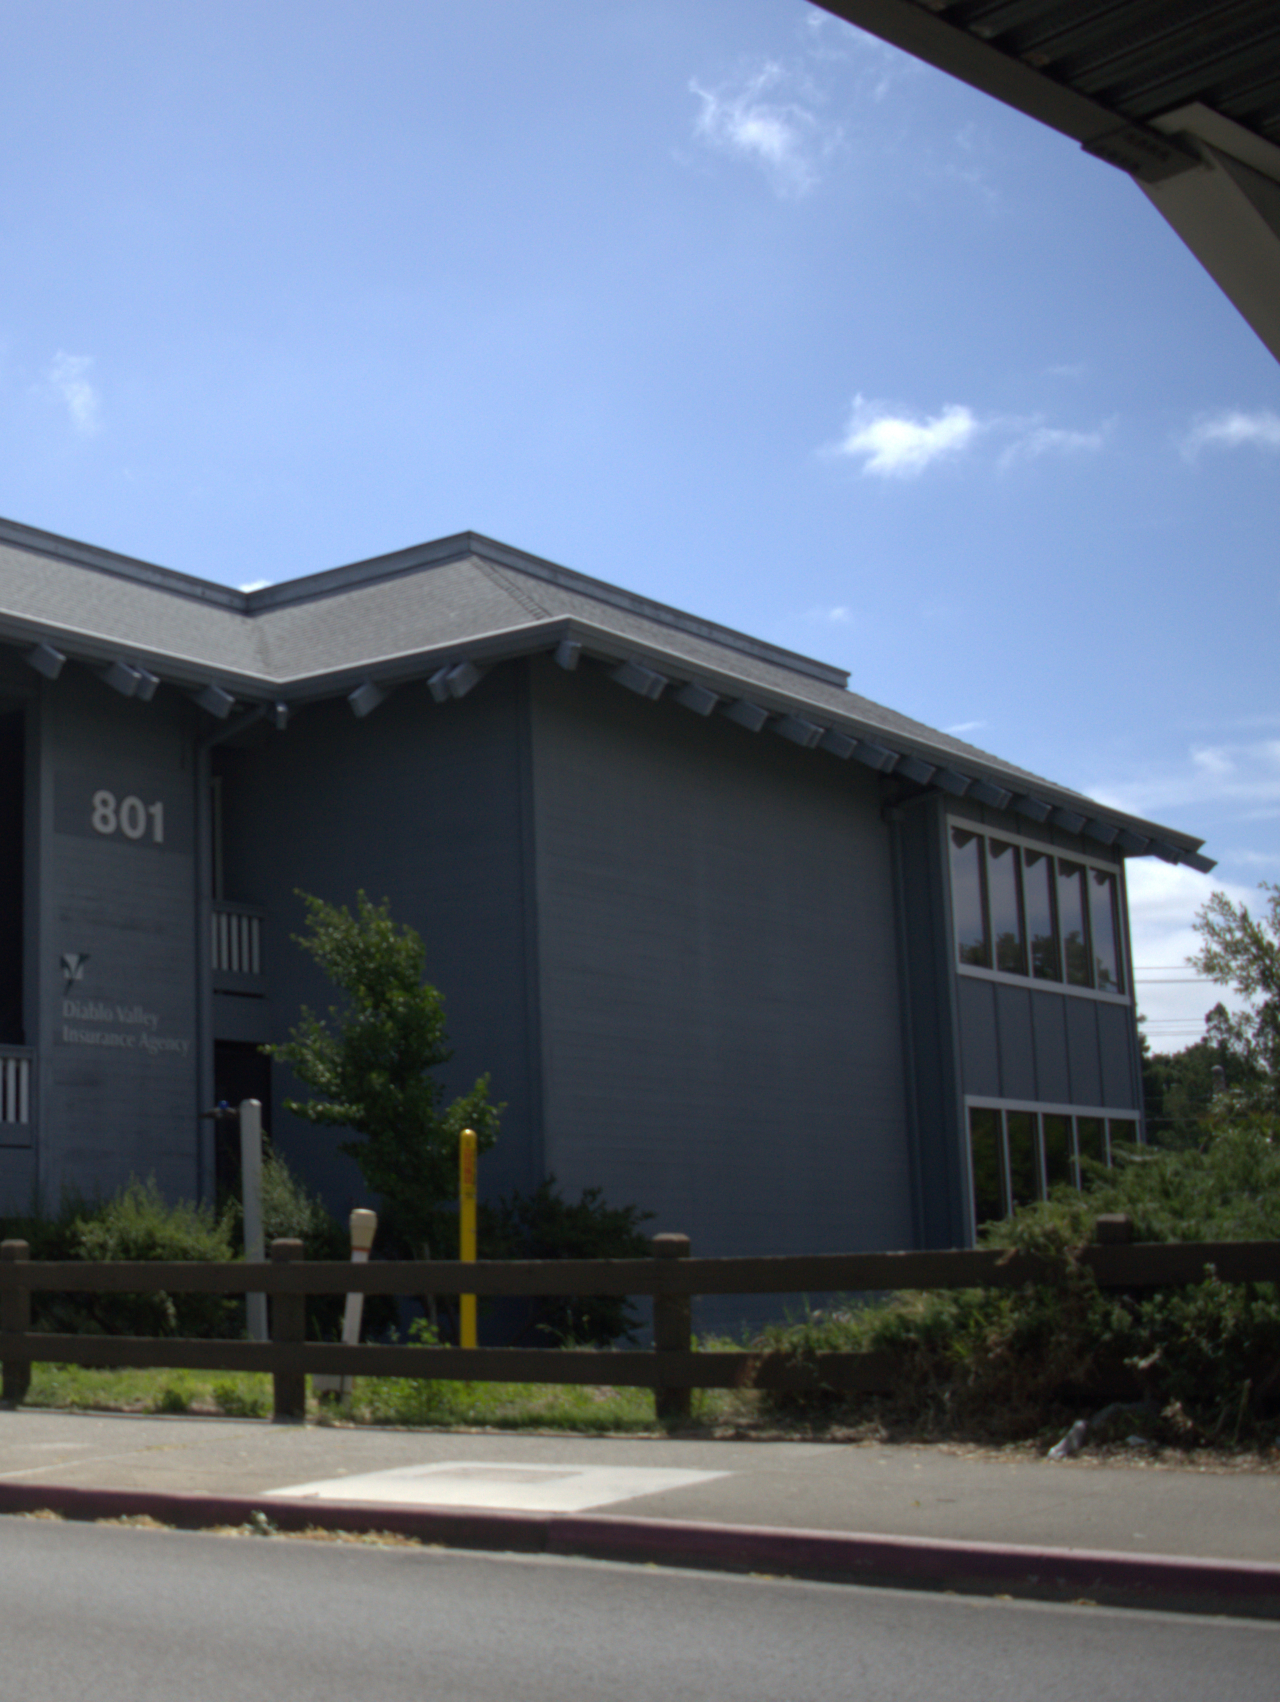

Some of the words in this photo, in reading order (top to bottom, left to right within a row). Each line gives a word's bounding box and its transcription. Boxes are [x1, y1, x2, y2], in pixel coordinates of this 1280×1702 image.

[91, 789, 164, 844] 801
[63, 1000, 114, 1021] Diablo
[116, 1005, 159, 1031] Valley
[63, 1024, 136, 1048] Insurance
[139, 1031, 189, 1057] Agency
